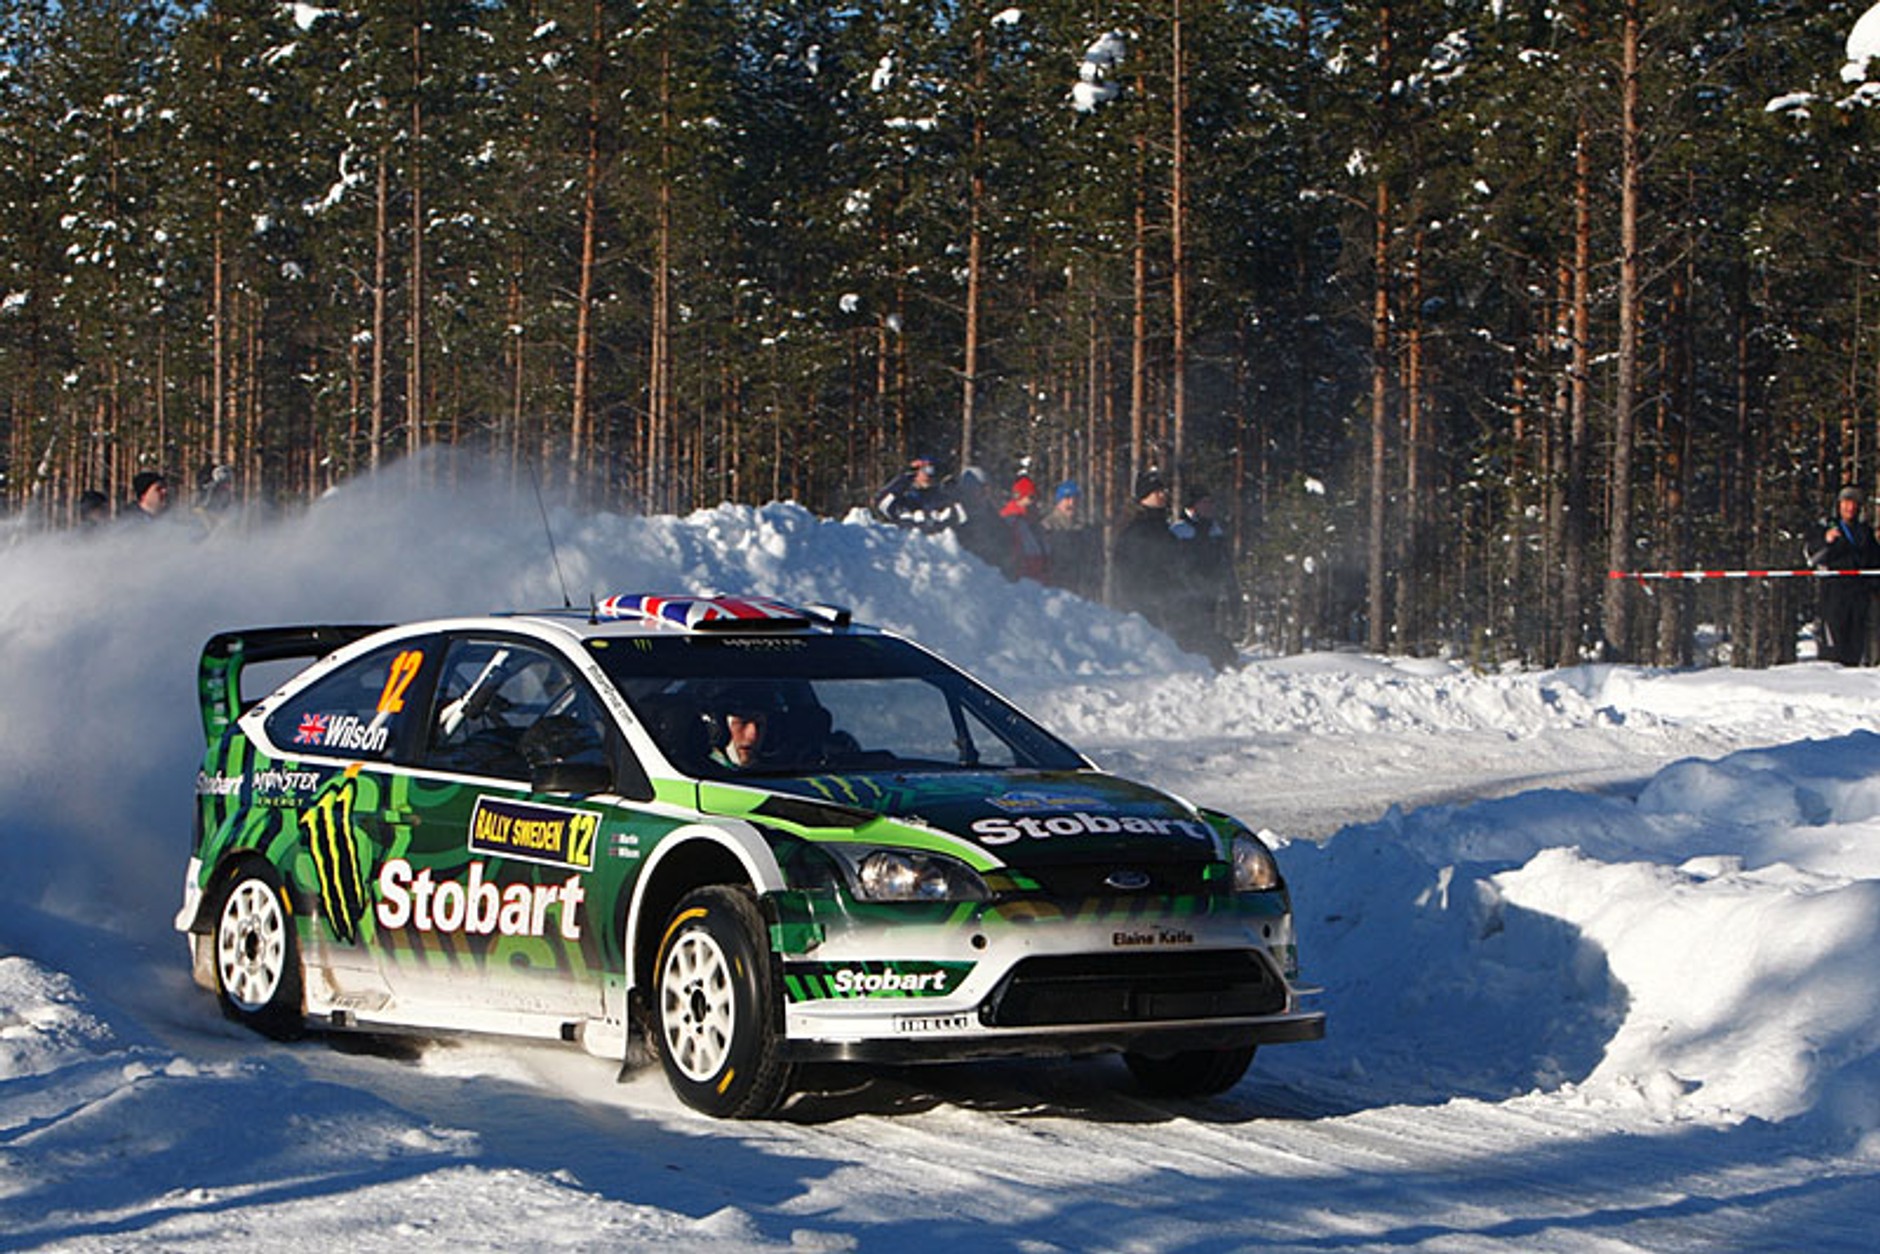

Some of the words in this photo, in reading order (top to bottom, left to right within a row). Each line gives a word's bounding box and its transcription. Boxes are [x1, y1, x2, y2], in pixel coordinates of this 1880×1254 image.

[376, 650, 424, 713] 12
[324, 715, 389, 751] Wilson
[196, 770, 244, 795] Stobart
[252, 768, 321, 793] MONSTER
[475, 807, 513, 844] RALLY
[511, 817, 565, 852] SWEDEN
[566, 812, 597, 867] 12
[971, 812, 1205, 846] Stobart
[376, 857, 586, 941] Stobart
[1112, 930, 1154, 946] Elaine
[834, 967, 947, 992] Stobart
